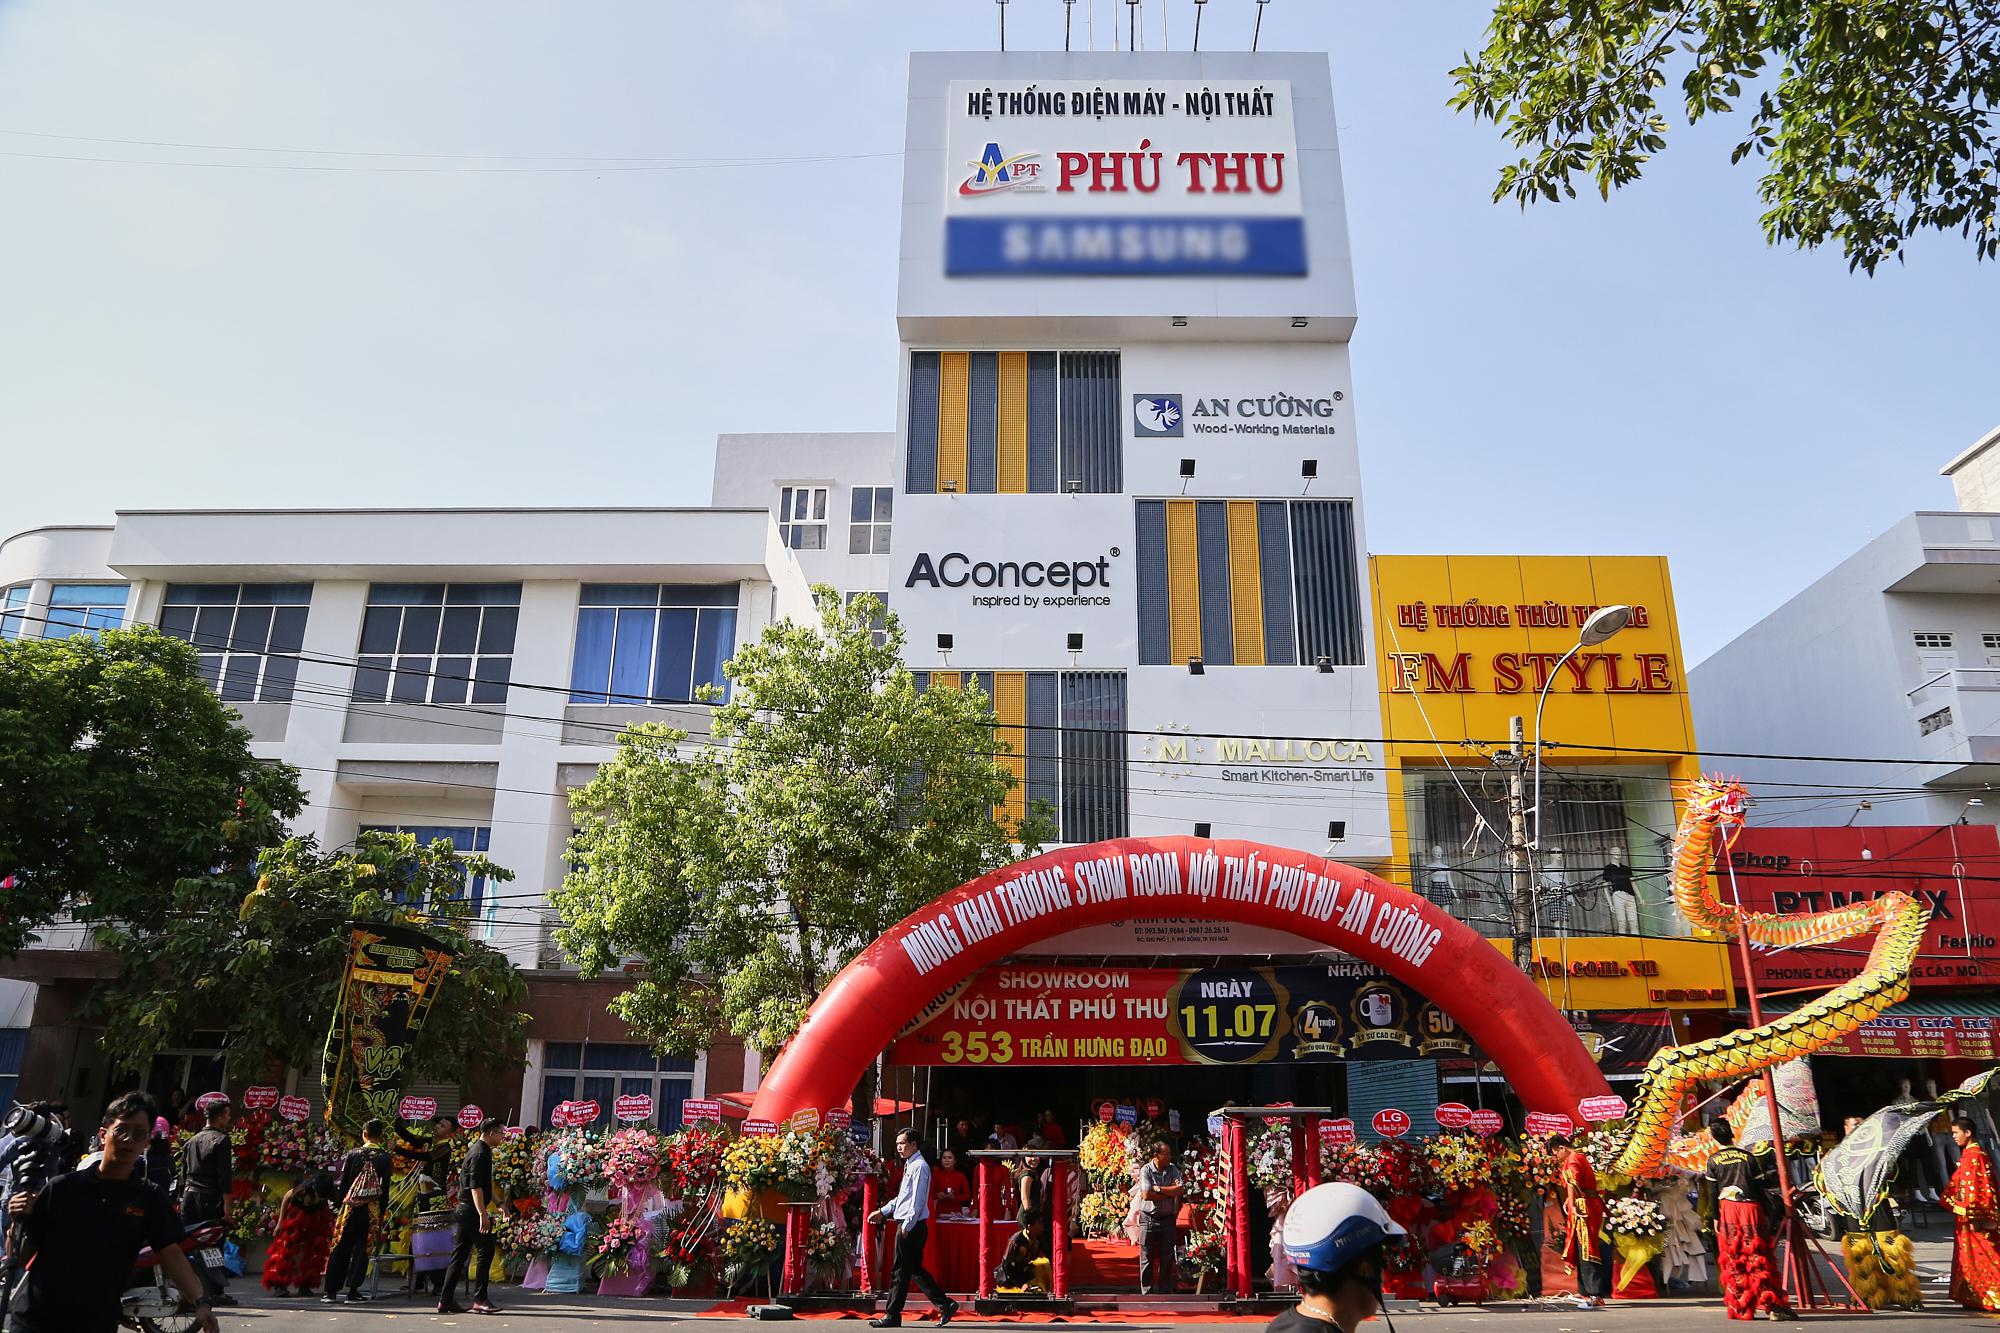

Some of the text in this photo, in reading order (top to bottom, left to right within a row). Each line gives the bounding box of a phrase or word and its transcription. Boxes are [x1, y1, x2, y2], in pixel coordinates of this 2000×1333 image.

[967, 87, 993, 120] HỆ
[997, 84, 1066, 118] THỐNG
[1071, 86, 1119, 120] ĐIỆN
[1123, 87, 1166, 117] MÁY
[1186, 86, 1221, 121] NỘI
[1224, 85, 1274, 117] THẤT
[1056, 138, 1164, 193] PHÚ
[1177, 151, 1284, 194] THU
[1191, 398, 1230, 418] AN
[1282, 424, 1335, 436] Materials
[1023, 594, 1040, 609] by
[1042, 595, 1111, 609] experience
[1397, 600, 1428, 632] HỆ
[1433, 597, 1511, 628] THỐNG
[1515, 600, 1570, 628] THỜI
[1388, 651, 1674, 694] FM STYLE
[1217, 738, 1374, 763] MALLOCA
[1221, 769, 1259, 782] Smart
[1352, 769, 1375, 782] Life
[1731, 851, 1791, 871] Shop
[953, 890, 1005, 946] KHAI
[1074, 855, 1128, 906] SHOW
[1129, 851, 1182, 898] ROOM
[1187, 848, 1219, 903] NỘI
[1222, 850, 1268, 904] THẤT
[1265, 863, 1307, 912] PHÚ
[999, 971, 1130, 989] SHOWROOM
[1200, 979, 1254, 999] NGÀY
[954, 994, 997, 1026] NỘI
[1003, 990, 1062, 1021] THẤT
[1069, 992, 1117, 1020] PHÚ
[1123, 998, 1168, 1019] THU
[1181, 1004, 1276, 1038] 11.07
[1304, 1010, 1322, 1039] 4
[941, 1030, 1014, 1064] 353
[1020, 1031, 1068, 1059] TRẦN
[1074, 1036, 1125, 1059] HƯNG
[1130, 1037, 1168, 1062] ĐẠO
[1381, 1112, 1402, 1123] LG
